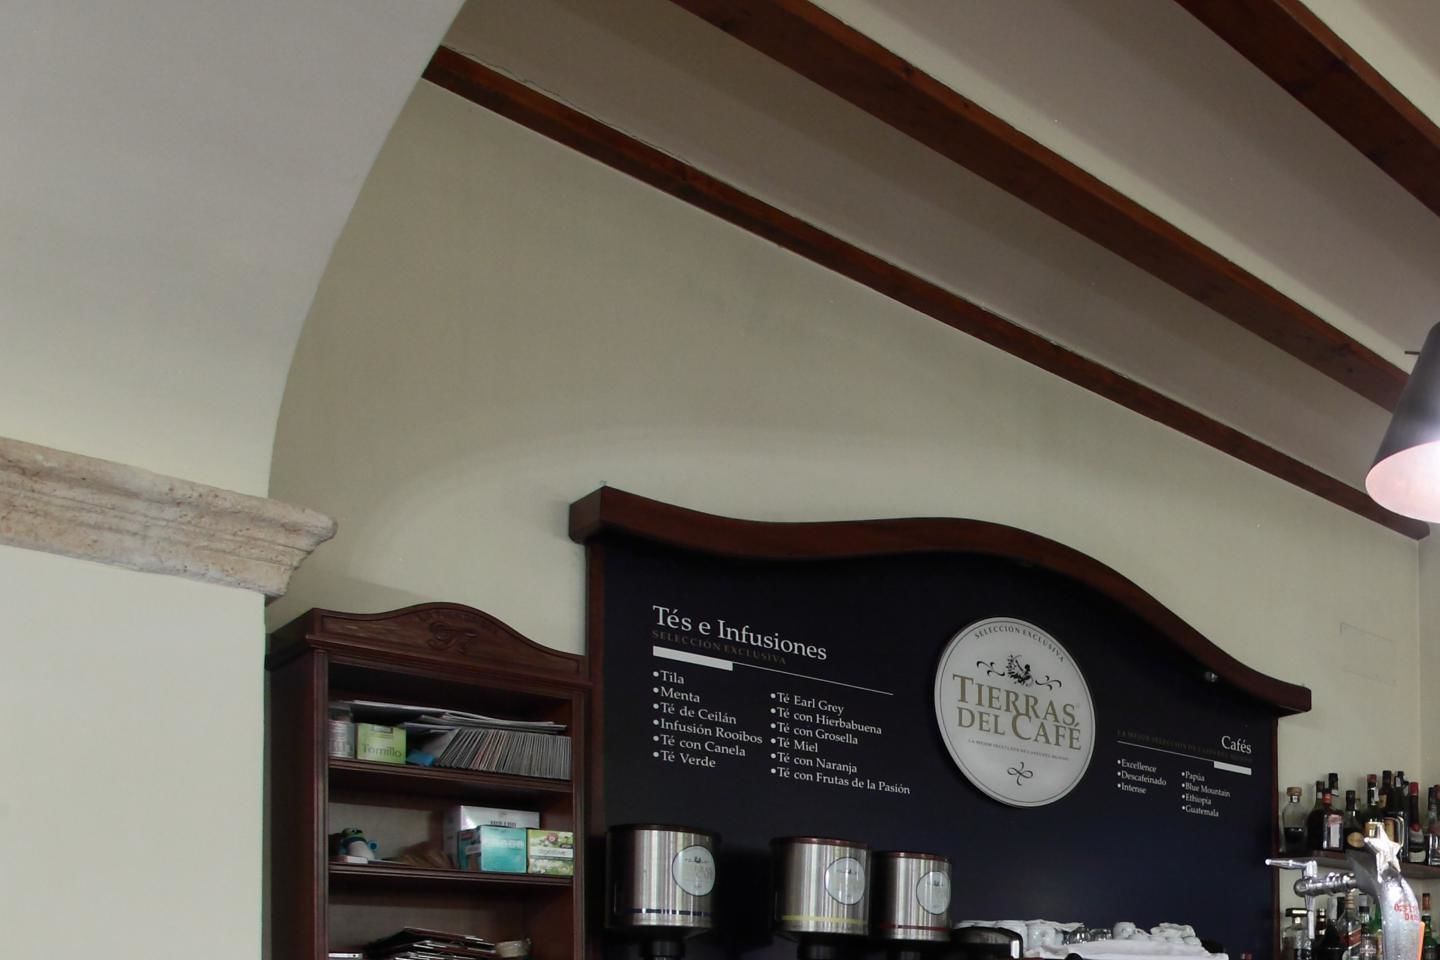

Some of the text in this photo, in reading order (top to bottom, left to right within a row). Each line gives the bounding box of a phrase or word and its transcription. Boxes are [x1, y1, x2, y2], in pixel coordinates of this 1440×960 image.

[652, 604, 827, 661] Tés e Infusiones
[723, 645, 786, 665] EXCLUSIVA
[1022, 630, 1064, 662] EXCLUSIVA
[660, 670, 685, 684] Tila
[660, 686, 700, 703] Menta
[776, 692, 844, 716] Té Earl Grey
[952, 673, 1075, 726] TIERRAS
[660, 702, 737, 725] Té de Ceilán
[776, 707, 882, 735] Té con Hierbabuena
[660, 718, 763, 744] Infusión Rooibos
[776, 722, 858, 744] Té con Grosella
[956, 706, 1006, 736] DEL
[1011, 712, 1082, 751] CAFÉ
[660, 734, 746, 757] Té con Canela
[776, 737, 818, 753] Té Miel
[1221, 735, 1252, 754] Cafés
[660, 750, 716, 768] Té Verde
[776, 752, 858, 775] Té con Naranja
[1121, 759, 1157, 773] Excellence
[776, 766, 910, 795] Té con Frutas de la Pasión
[1121, 770, 1167, 786] Descafeinado
[1121, 782, 1147, 794] Intense
[1185, 782, 1231, 798] Blue Mountain
[1185, 793, 1212, 806] Ethiopia
[1185, 804, 1219, 817] Guatemala
